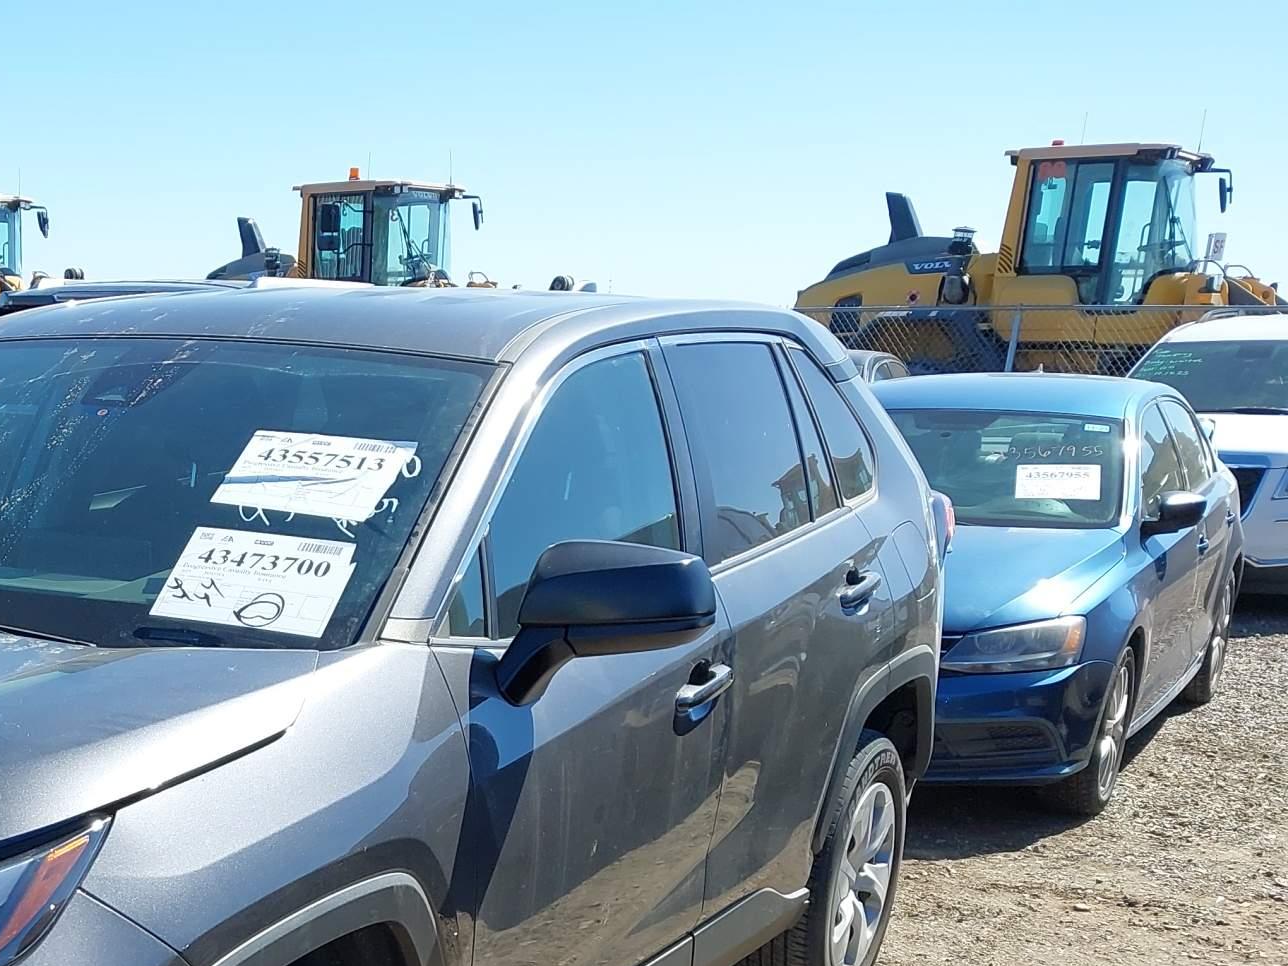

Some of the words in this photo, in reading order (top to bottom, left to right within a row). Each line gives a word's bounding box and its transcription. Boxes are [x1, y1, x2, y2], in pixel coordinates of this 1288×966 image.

[912, 261, 952, 270] VOLV
[257, 448, 386, 472] 43557513
[197, 548, 332, 578] 43473700
